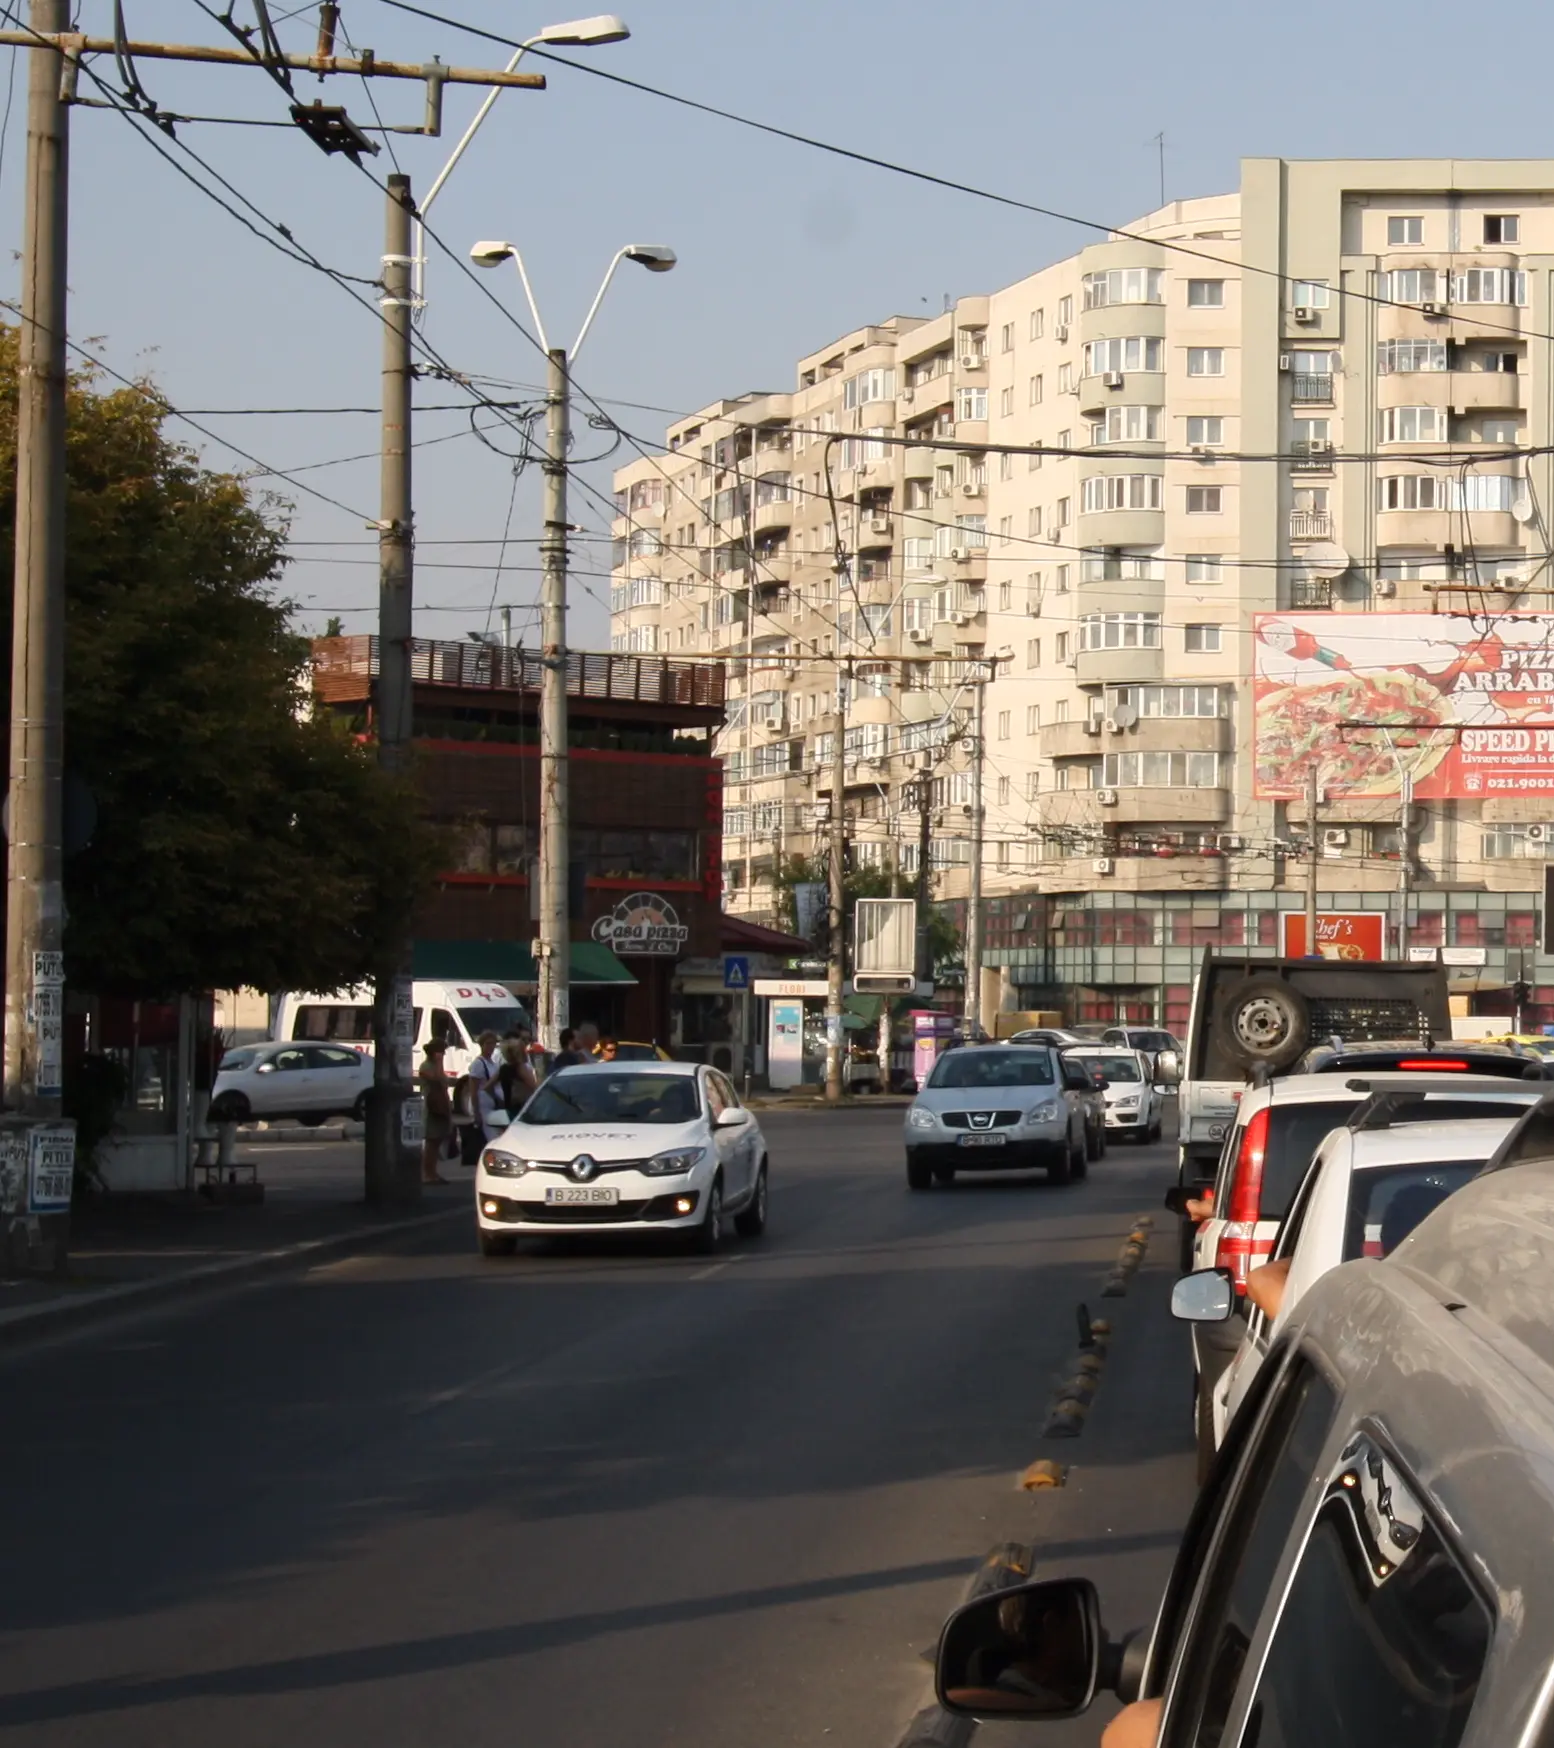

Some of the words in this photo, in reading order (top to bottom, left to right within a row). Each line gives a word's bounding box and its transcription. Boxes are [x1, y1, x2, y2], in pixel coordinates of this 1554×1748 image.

[1461, 729, 1530, 752] SPEED
[1461, 754, 1499, 764] Livrare
[1487, 777, 1554, 789] 021.9001
[555, 1190, 564, 1201] B
[567, 1190, 588, 1201] 223
